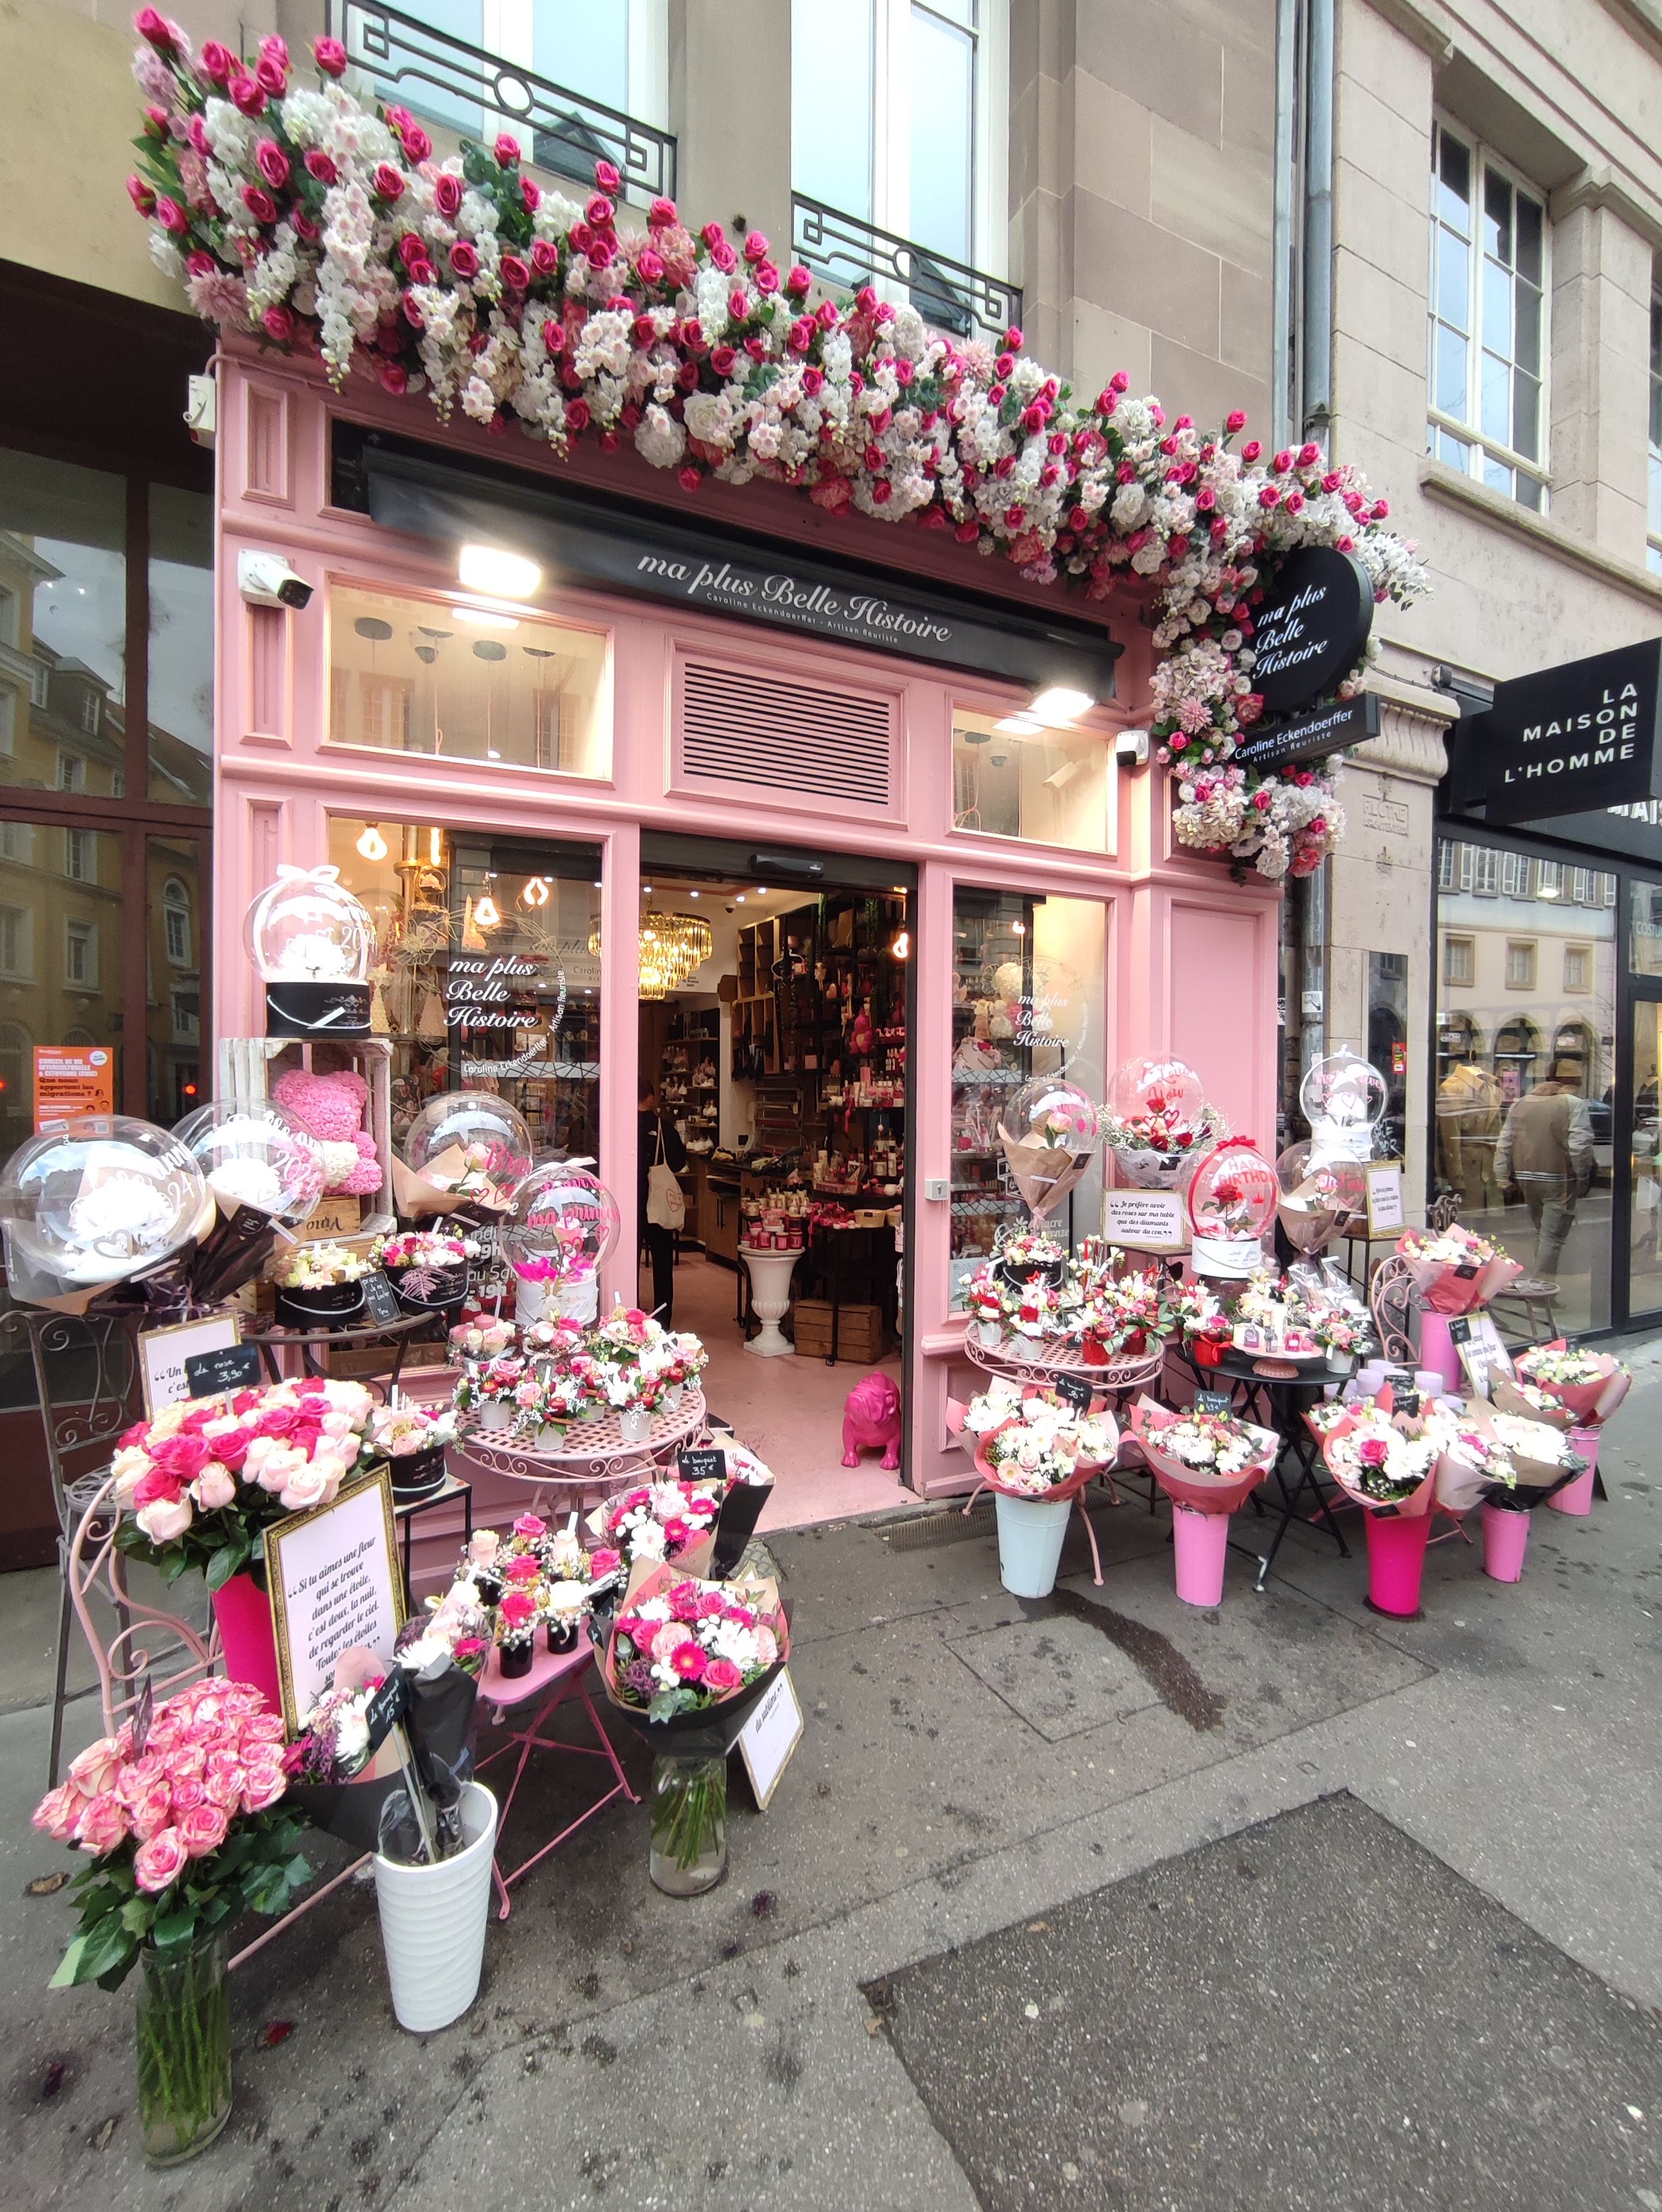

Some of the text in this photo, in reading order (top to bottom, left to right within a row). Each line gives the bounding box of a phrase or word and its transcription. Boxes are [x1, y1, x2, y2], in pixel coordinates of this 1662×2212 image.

[637, 556, 952, 642] ma plus Belle Histoire
[706, 592, 747, 609] Caroline
[752, 602, 816, 624] Eckendoerffer
[827, 620, 859, 635] Artisan
[1257, 584, 1327, 629] ma plus
[1255, 617, 1305, 654] Belle
[1253, 640, 1327, 680] Histoire
[1603, 683, 1638, 703] LA
[1234, 709, 1353, 759] Caroline Eckendoerffer
[1523, 702, 1638, 742] MAISON
[1599, 723, 1636, 745] DE
[1253, 748, 1286, 763] Artisan
[1505, 743, 1634, 783] L'HOMME
[449, 955, 537, 981] ma plus
[446, 980, 511, 1002] Belle
[443, 1006, 538, 1028] Histoire
[464, 1063, 498, 1074] Caroline
[548, 1003, 566, 1032] Artisan
[1013, 1030, 1070, 1048] Histoire
[692, 1455, 717, 1466] bouquet
[298, 1579, 308, 1594] Si
[308, 1574, 317, 1585] tu
[318, 1559, 343, 1580] aimes
[343, 1548, 357, 1564] une
[357, 1536, 376, 1558] fleur
[316, 1562, 364, 1602] qui se trouve
[308, 1621, 327, 1641] c'est
[350, 1598, 360, 1611] la
[312, 1600, 333, 1621] dans
[334, 1590, 348, 1606] une
[308, 1647, 319, 1660] de
[320, 1617, 356, 1652] regarder
[356, 1612, 364, 1624] le
[354, 1620, 378, 1644] étoiles
